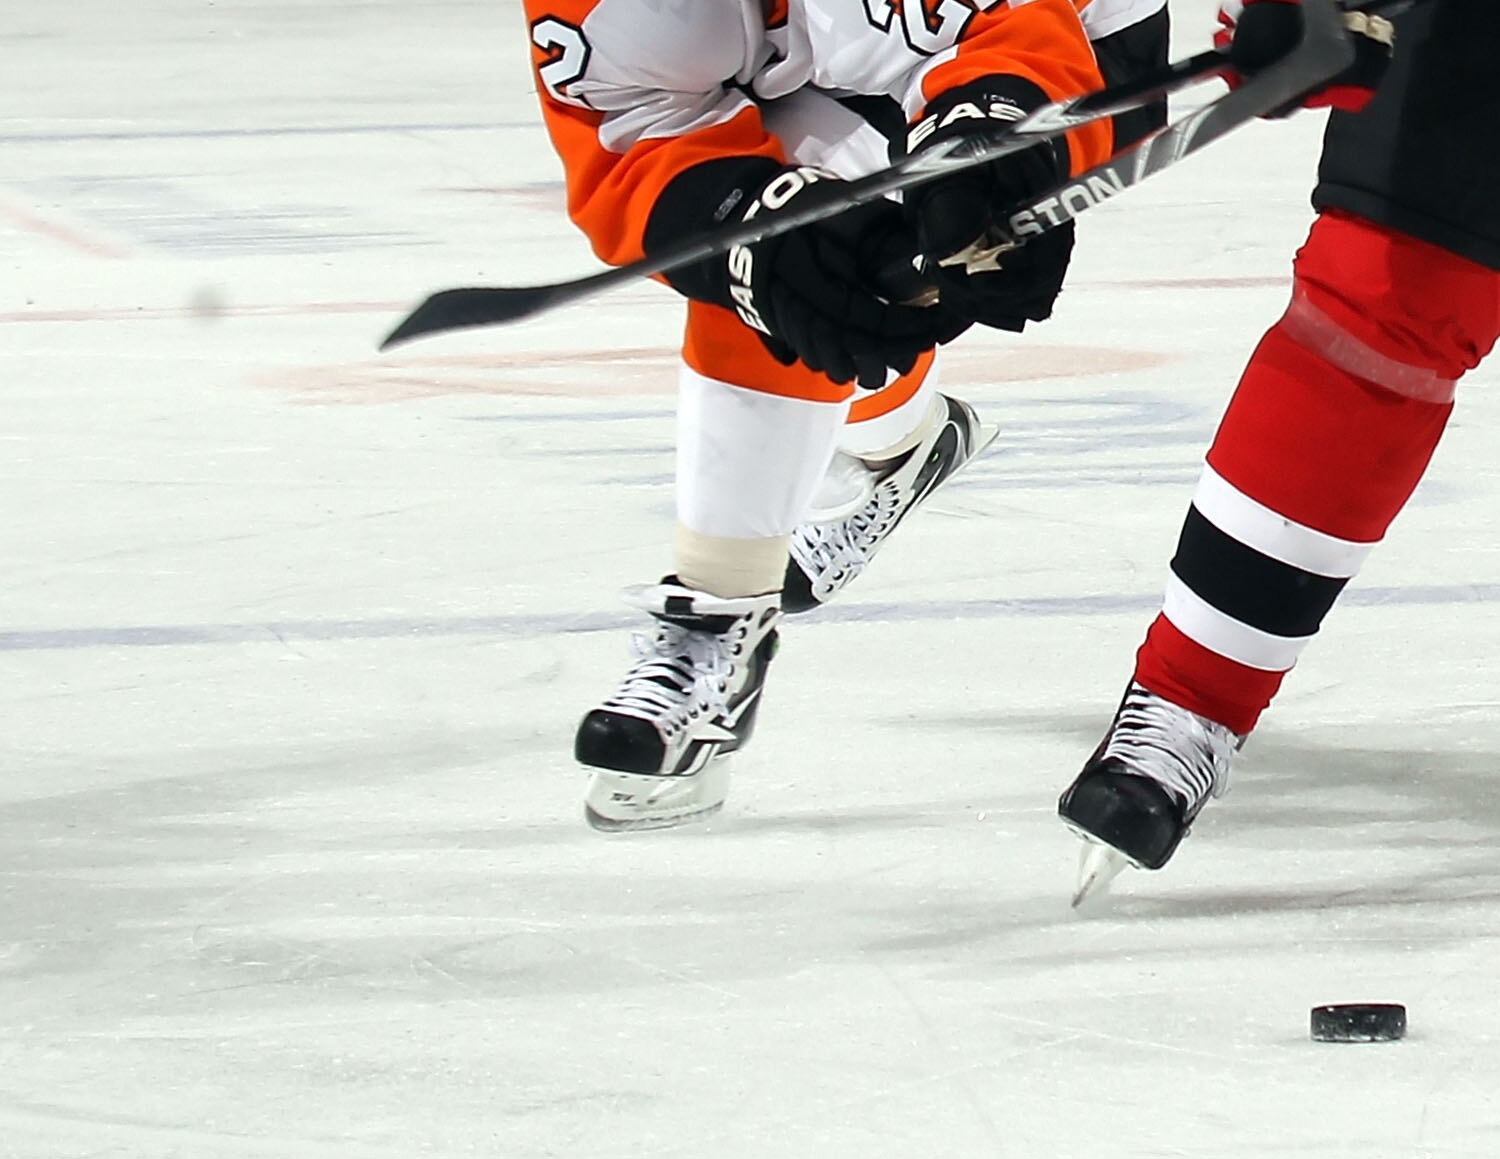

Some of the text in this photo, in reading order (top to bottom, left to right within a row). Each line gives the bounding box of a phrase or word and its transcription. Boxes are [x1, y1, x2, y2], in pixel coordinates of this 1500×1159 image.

[530, 13, 592, 102] 2
[906, 101, 1030, 155] EAS
[1008, 167, 1126, 238] STON
